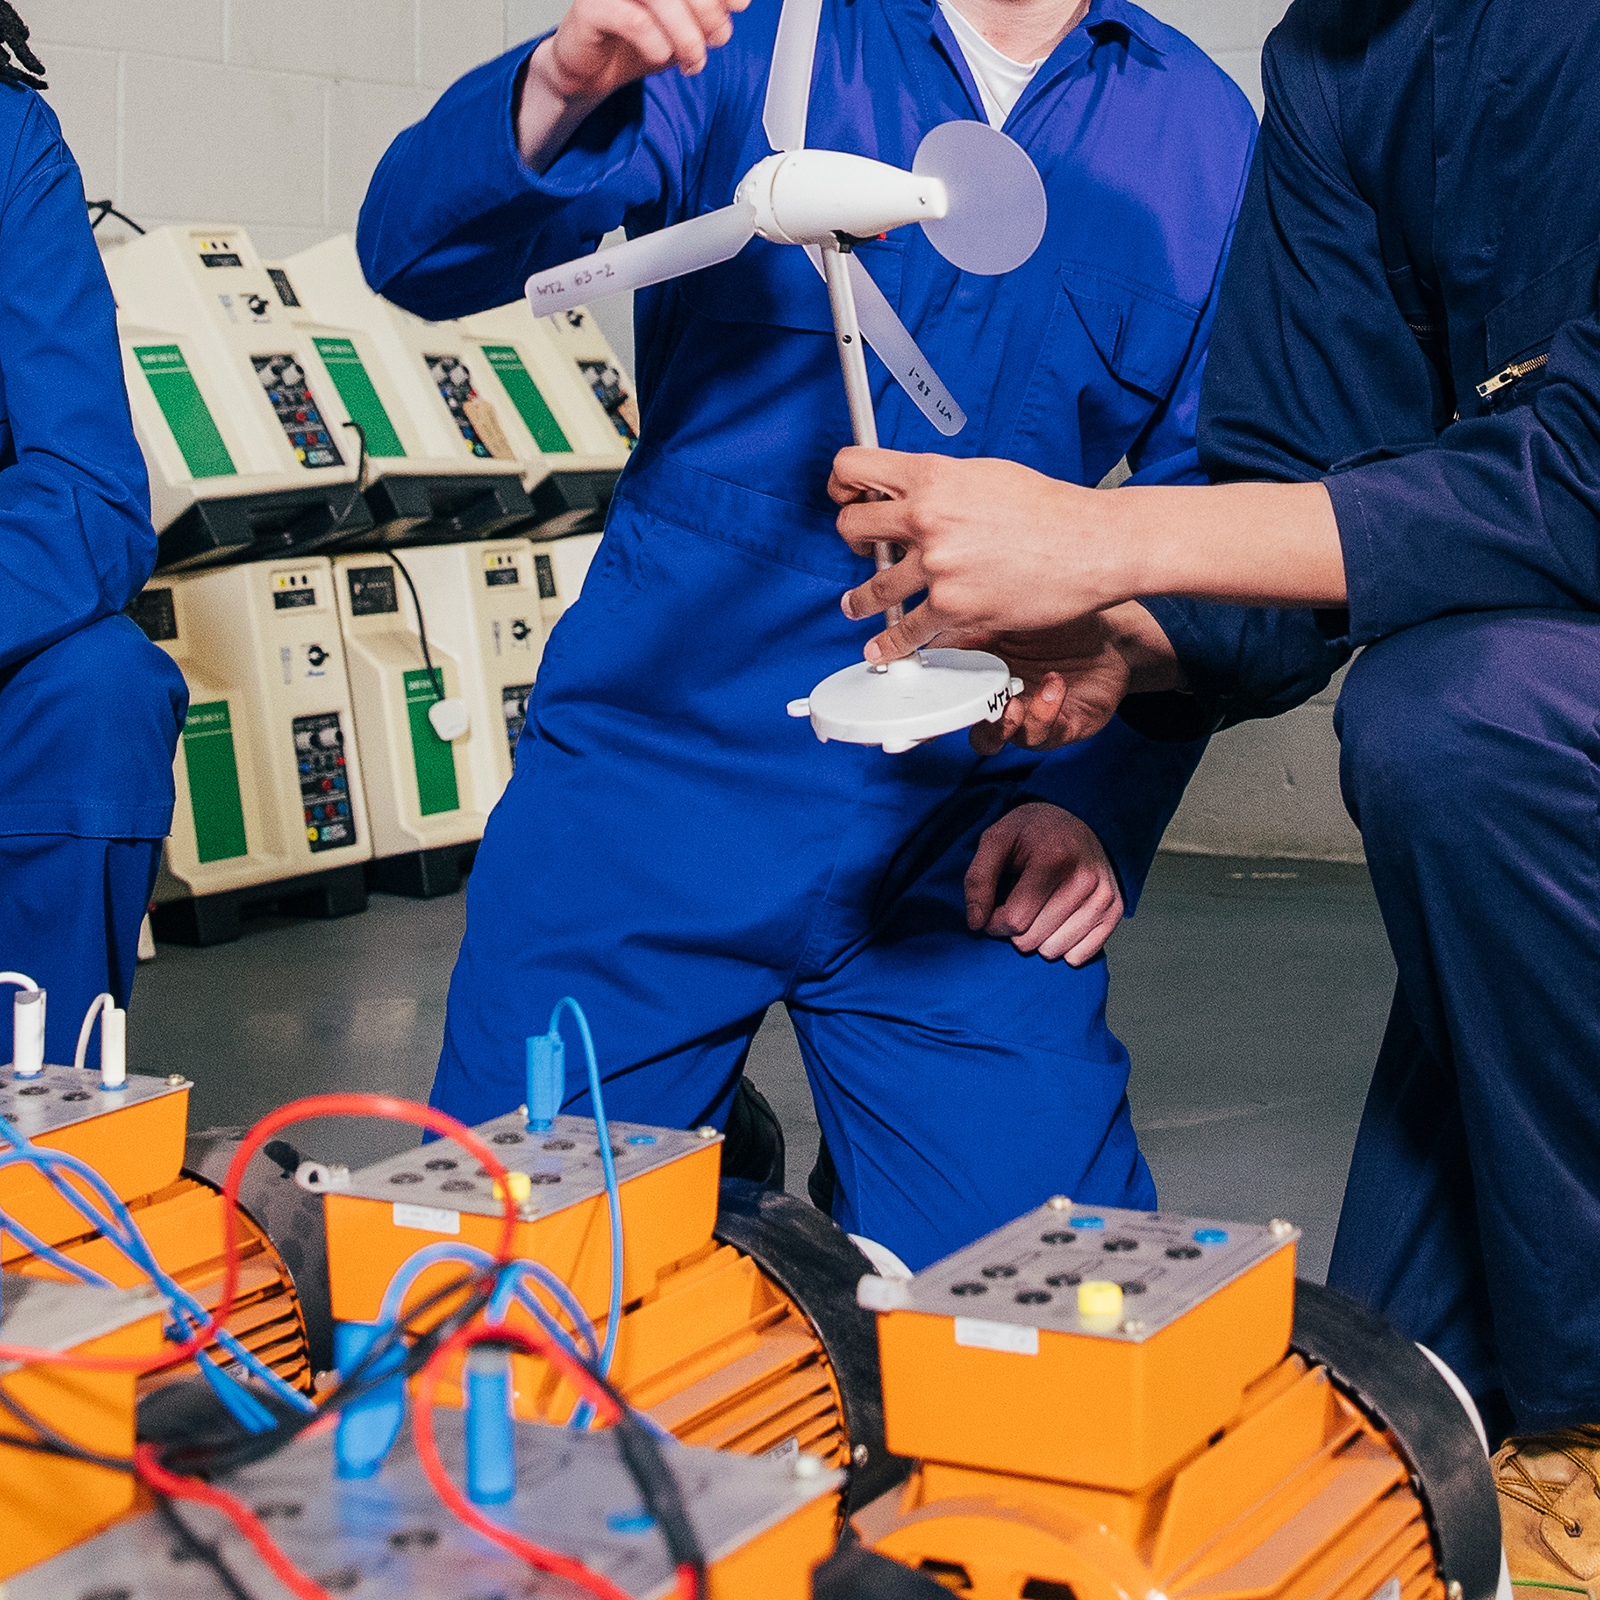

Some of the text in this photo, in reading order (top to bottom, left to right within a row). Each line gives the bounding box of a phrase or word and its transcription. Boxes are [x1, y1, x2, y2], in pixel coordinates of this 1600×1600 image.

[536, 263, 615, 295] WT2 63-2
[936, 399, 952, 422] WT1
[986, 686, 1011, 714] WT2
